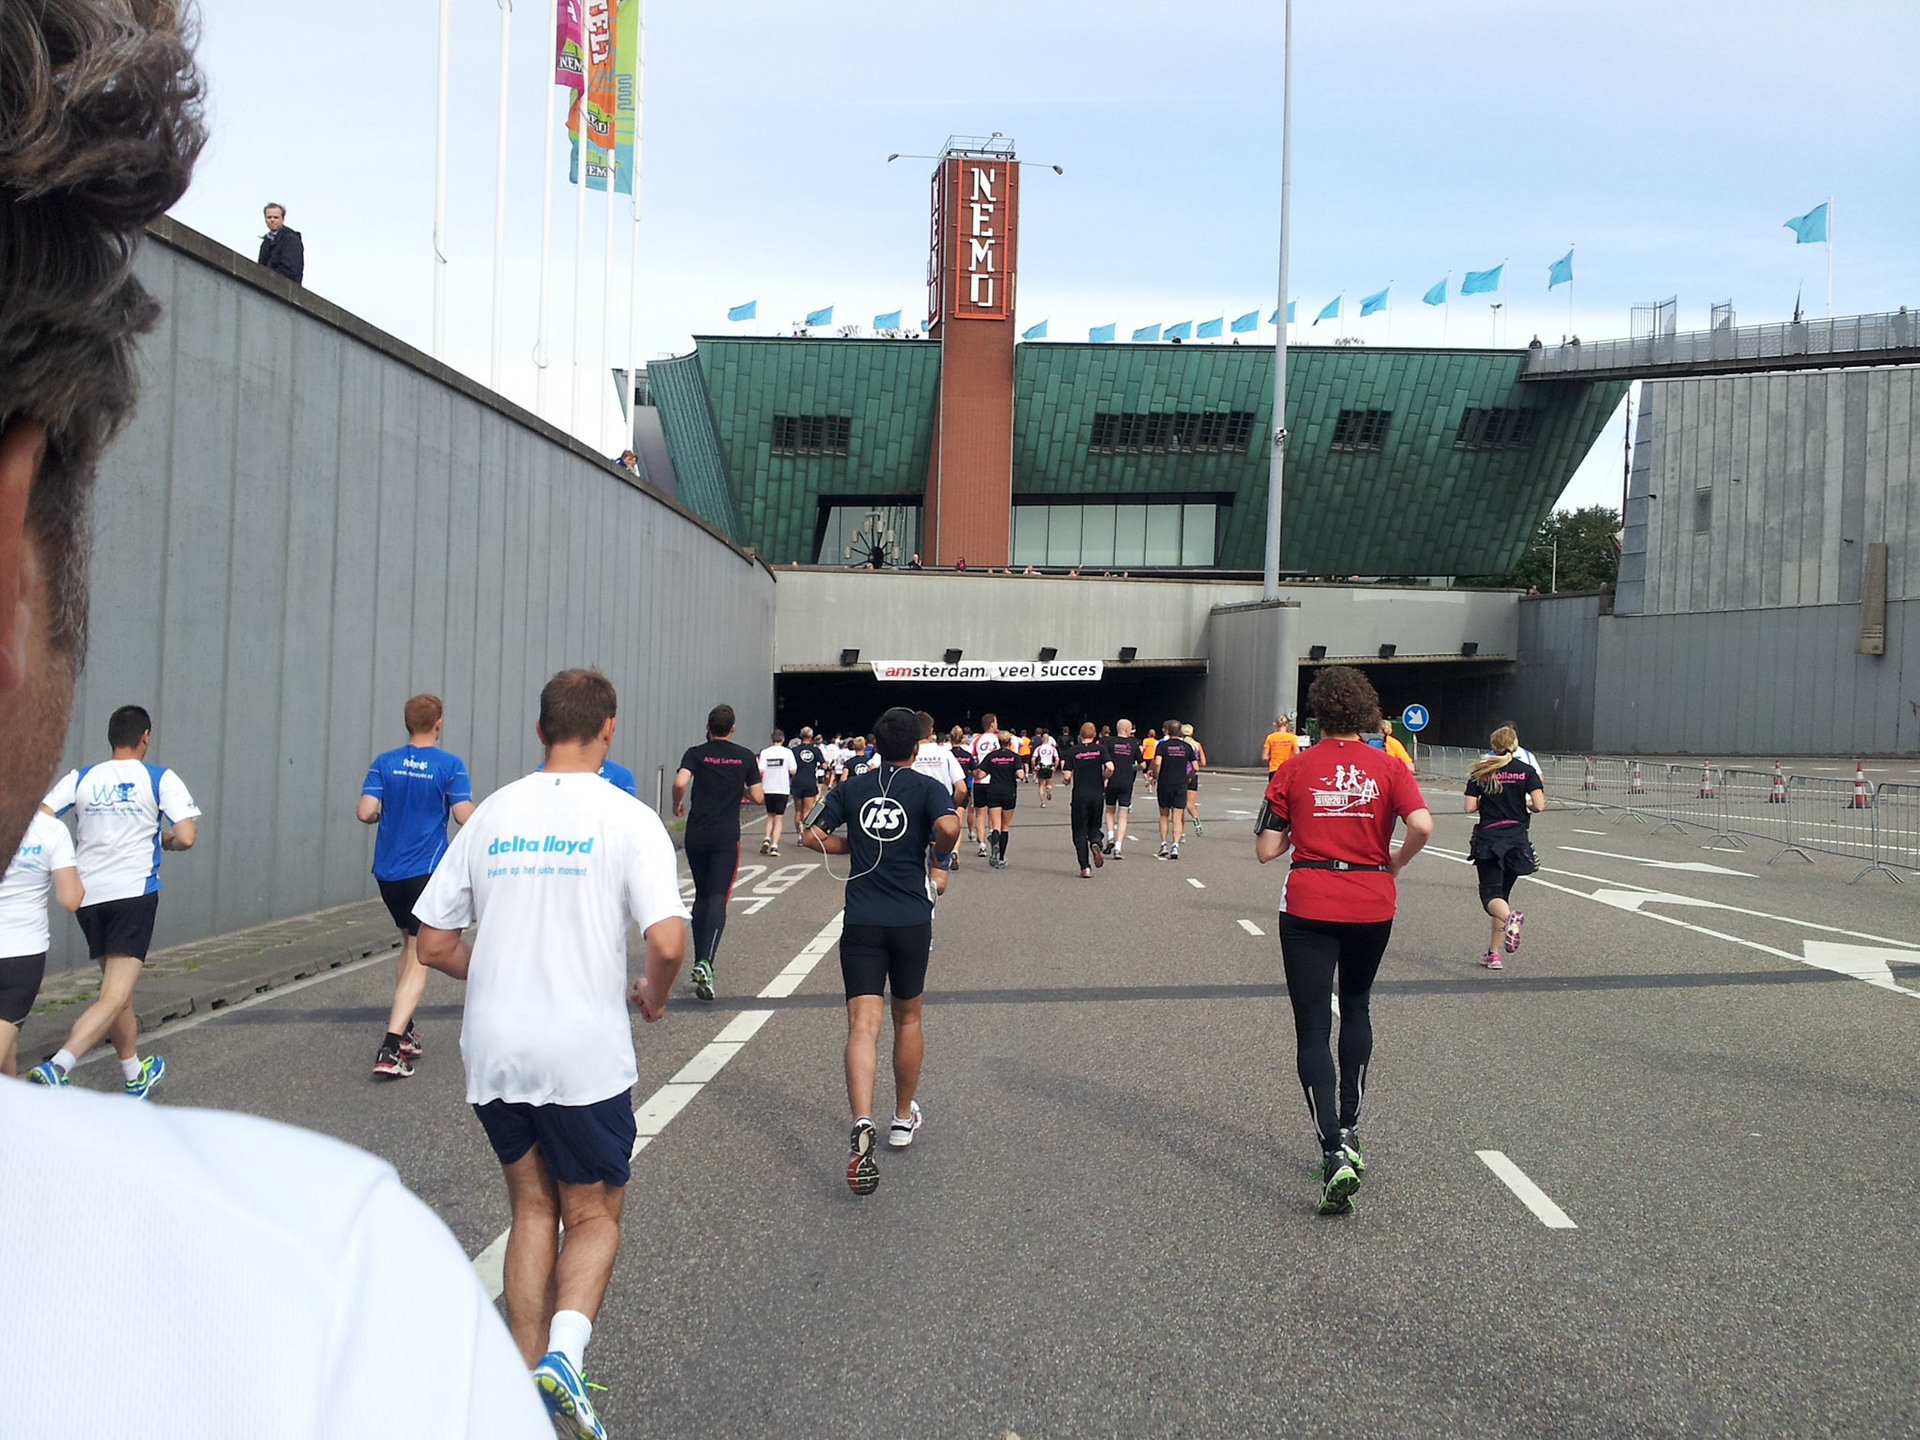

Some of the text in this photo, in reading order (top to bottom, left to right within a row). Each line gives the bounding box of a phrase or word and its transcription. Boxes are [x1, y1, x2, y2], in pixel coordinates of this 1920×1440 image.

[968, 167, 996, 308] NEMO
[999, 663, 1035, 677] veel
[1041, 664, 1096, 678] succes
[488, 835, 595, 856] delta lloyd
[523, 865, 535, 876] het
[558, 867, 587, 877] moment
